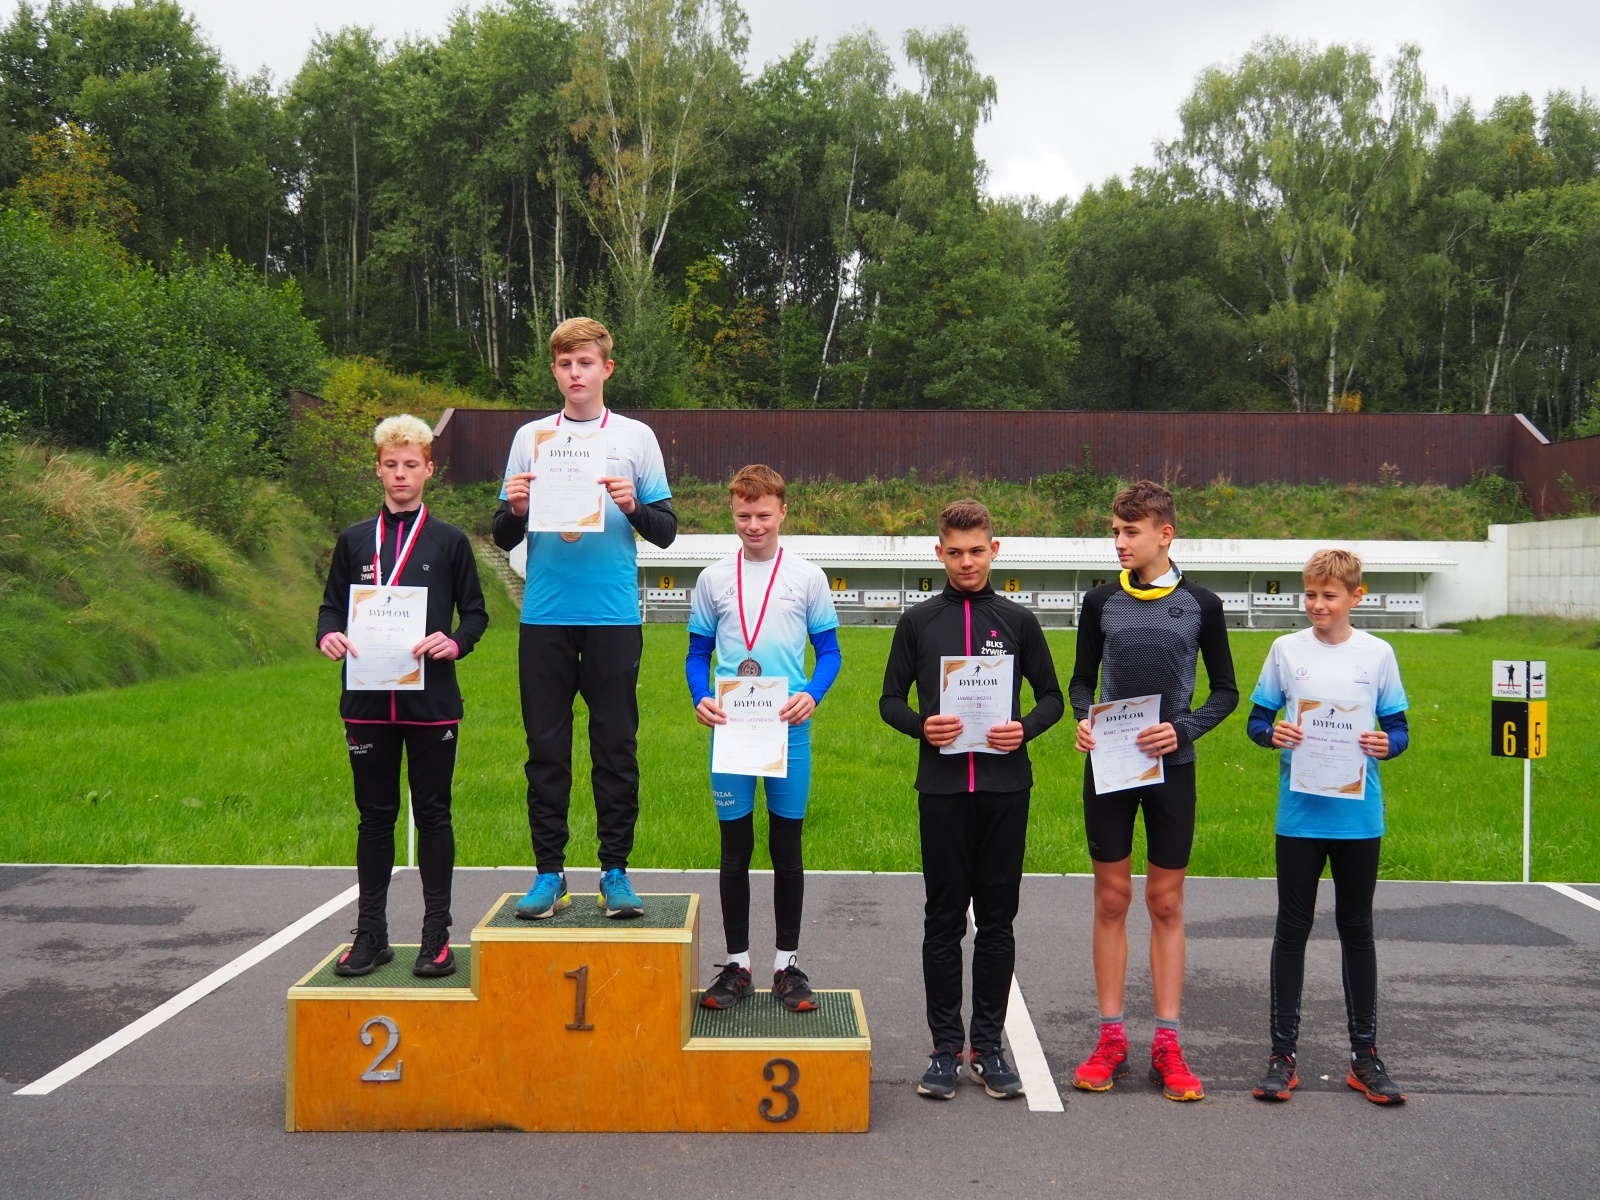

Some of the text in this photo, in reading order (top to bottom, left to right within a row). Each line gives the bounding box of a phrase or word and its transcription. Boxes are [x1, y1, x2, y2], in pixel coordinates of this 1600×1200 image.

[550, 450, 590, 458] DYPLOM
[362, 564, 375, 572] BLK
[663, 576, 670, 589] 9
[835, 577, 843, 590] 7
[922, 578, 929, 591] 6
[1009, 579, 1016, 591] 5
[1269, 581, 1277, 594] 2
[369, 609, 410, 618] DYPLOM
[985, 640, 1004, 649] BLKS
[981, 646, 1008, 656] ŻYWIEC
[959, 678, 998, 686] DYPLOM
[733, 700, 773, 708] DYPLOM
[1106, 711, 1144, 722] DYPLOM
[1312, 719, 1353, 730] DYPLOM
[1502, 720, 1517, 756] 6
[1534, 721, 1541, 756] 5
[565, 965, 594, 1031] 1
[360, 1015, 403, 1082] 2
[759, 1058, 800, 1123] 3
